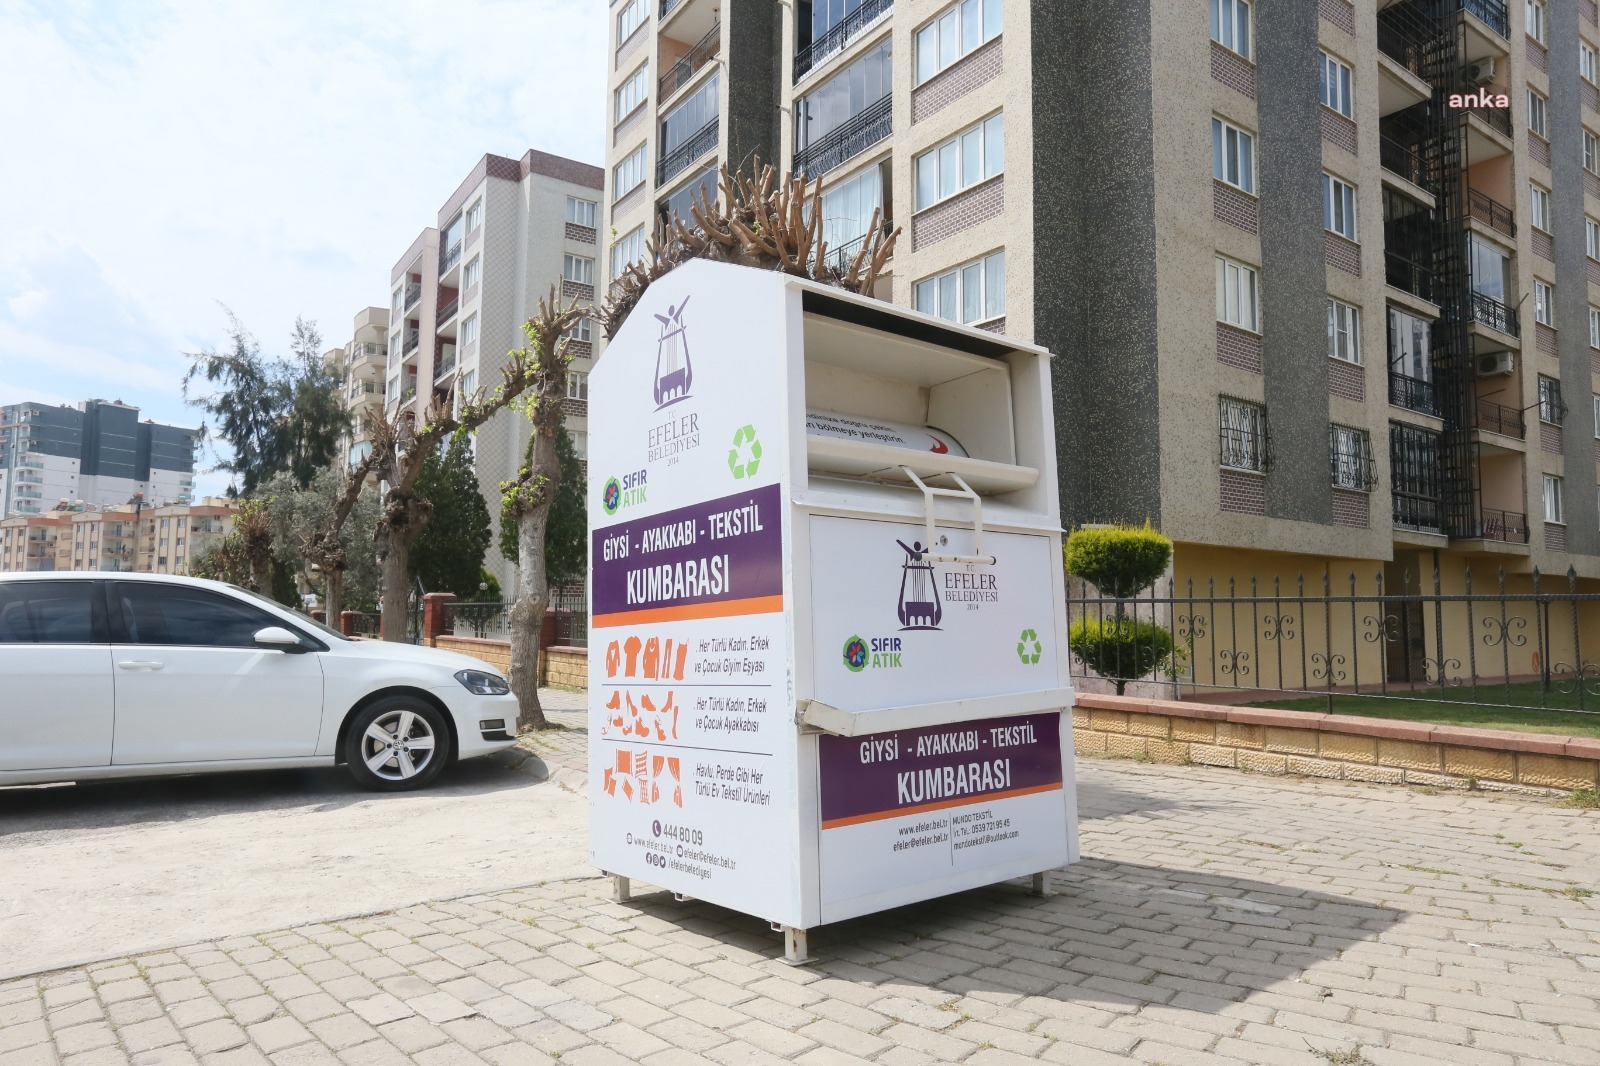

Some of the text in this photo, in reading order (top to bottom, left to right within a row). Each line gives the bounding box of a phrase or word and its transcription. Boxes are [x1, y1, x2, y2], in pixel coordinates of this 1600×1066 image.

[648, 412, 700, 448] EFELER
[815, 422, 858, 437] bölmeye
[858, 430, 906, 445] yerleştirin.
[648, 431, 700, 463] BELEDİYESİ
[667, 456, 679, 467] 2014
[623, 469, 647, 490] SIFIR
[623, 486, 647, 508] ATIK
[603, 529, 629, 561] GİYSİ
[641, 519, 696, 554] AYAKKABI
[708, 499, 764, 540] TEKSTİL
[626, 554, 730, 605] KUMBARASI
[945, 572, 998, 590] EFELER
[945, 589, 999, 603] BELEDİYESİ
[966, 603, 979, 611] 2014
[699, 638, 711, 653] Her
[711, 637, 728, 652] Türlü
[750, 634, 770, 651] Erkek
[870, 637, 902, 653] SIFIR
[694, 657, 765, 677] ve Çocuk Giyim Eşyası
[872, 652, 903, 669] ATIK
[696, 696, 708, 711] Her
[708, 696, 725, 712] Türlü
[747, 697, 767, 713] Erkek
[695, 714, 760, 735] ve Çocuk Ayakkabısı
[859, 733, 899, 764] GİYSİ
[916, 730, 979, 758] AYAKKABI
[989, 720, 1038, 748] TEKSTİL
[696, 762, 764, 785] Havlu, Perde Gibi Her
[897, 758, 1011, 805] KUMBARASI
[695, 780, 771, 807] Türlü Ev Tekstil Ürünleri
[898, 818, 948, 836] www.efeler.bel.tr
[952, 814, 972, 826] MUNDO
[1003, 818, 1011, 828] 45
[663, 823, 703, 847] 444 80 09
[893, 832, 949, 852] efeler@efeler.bel.tr
